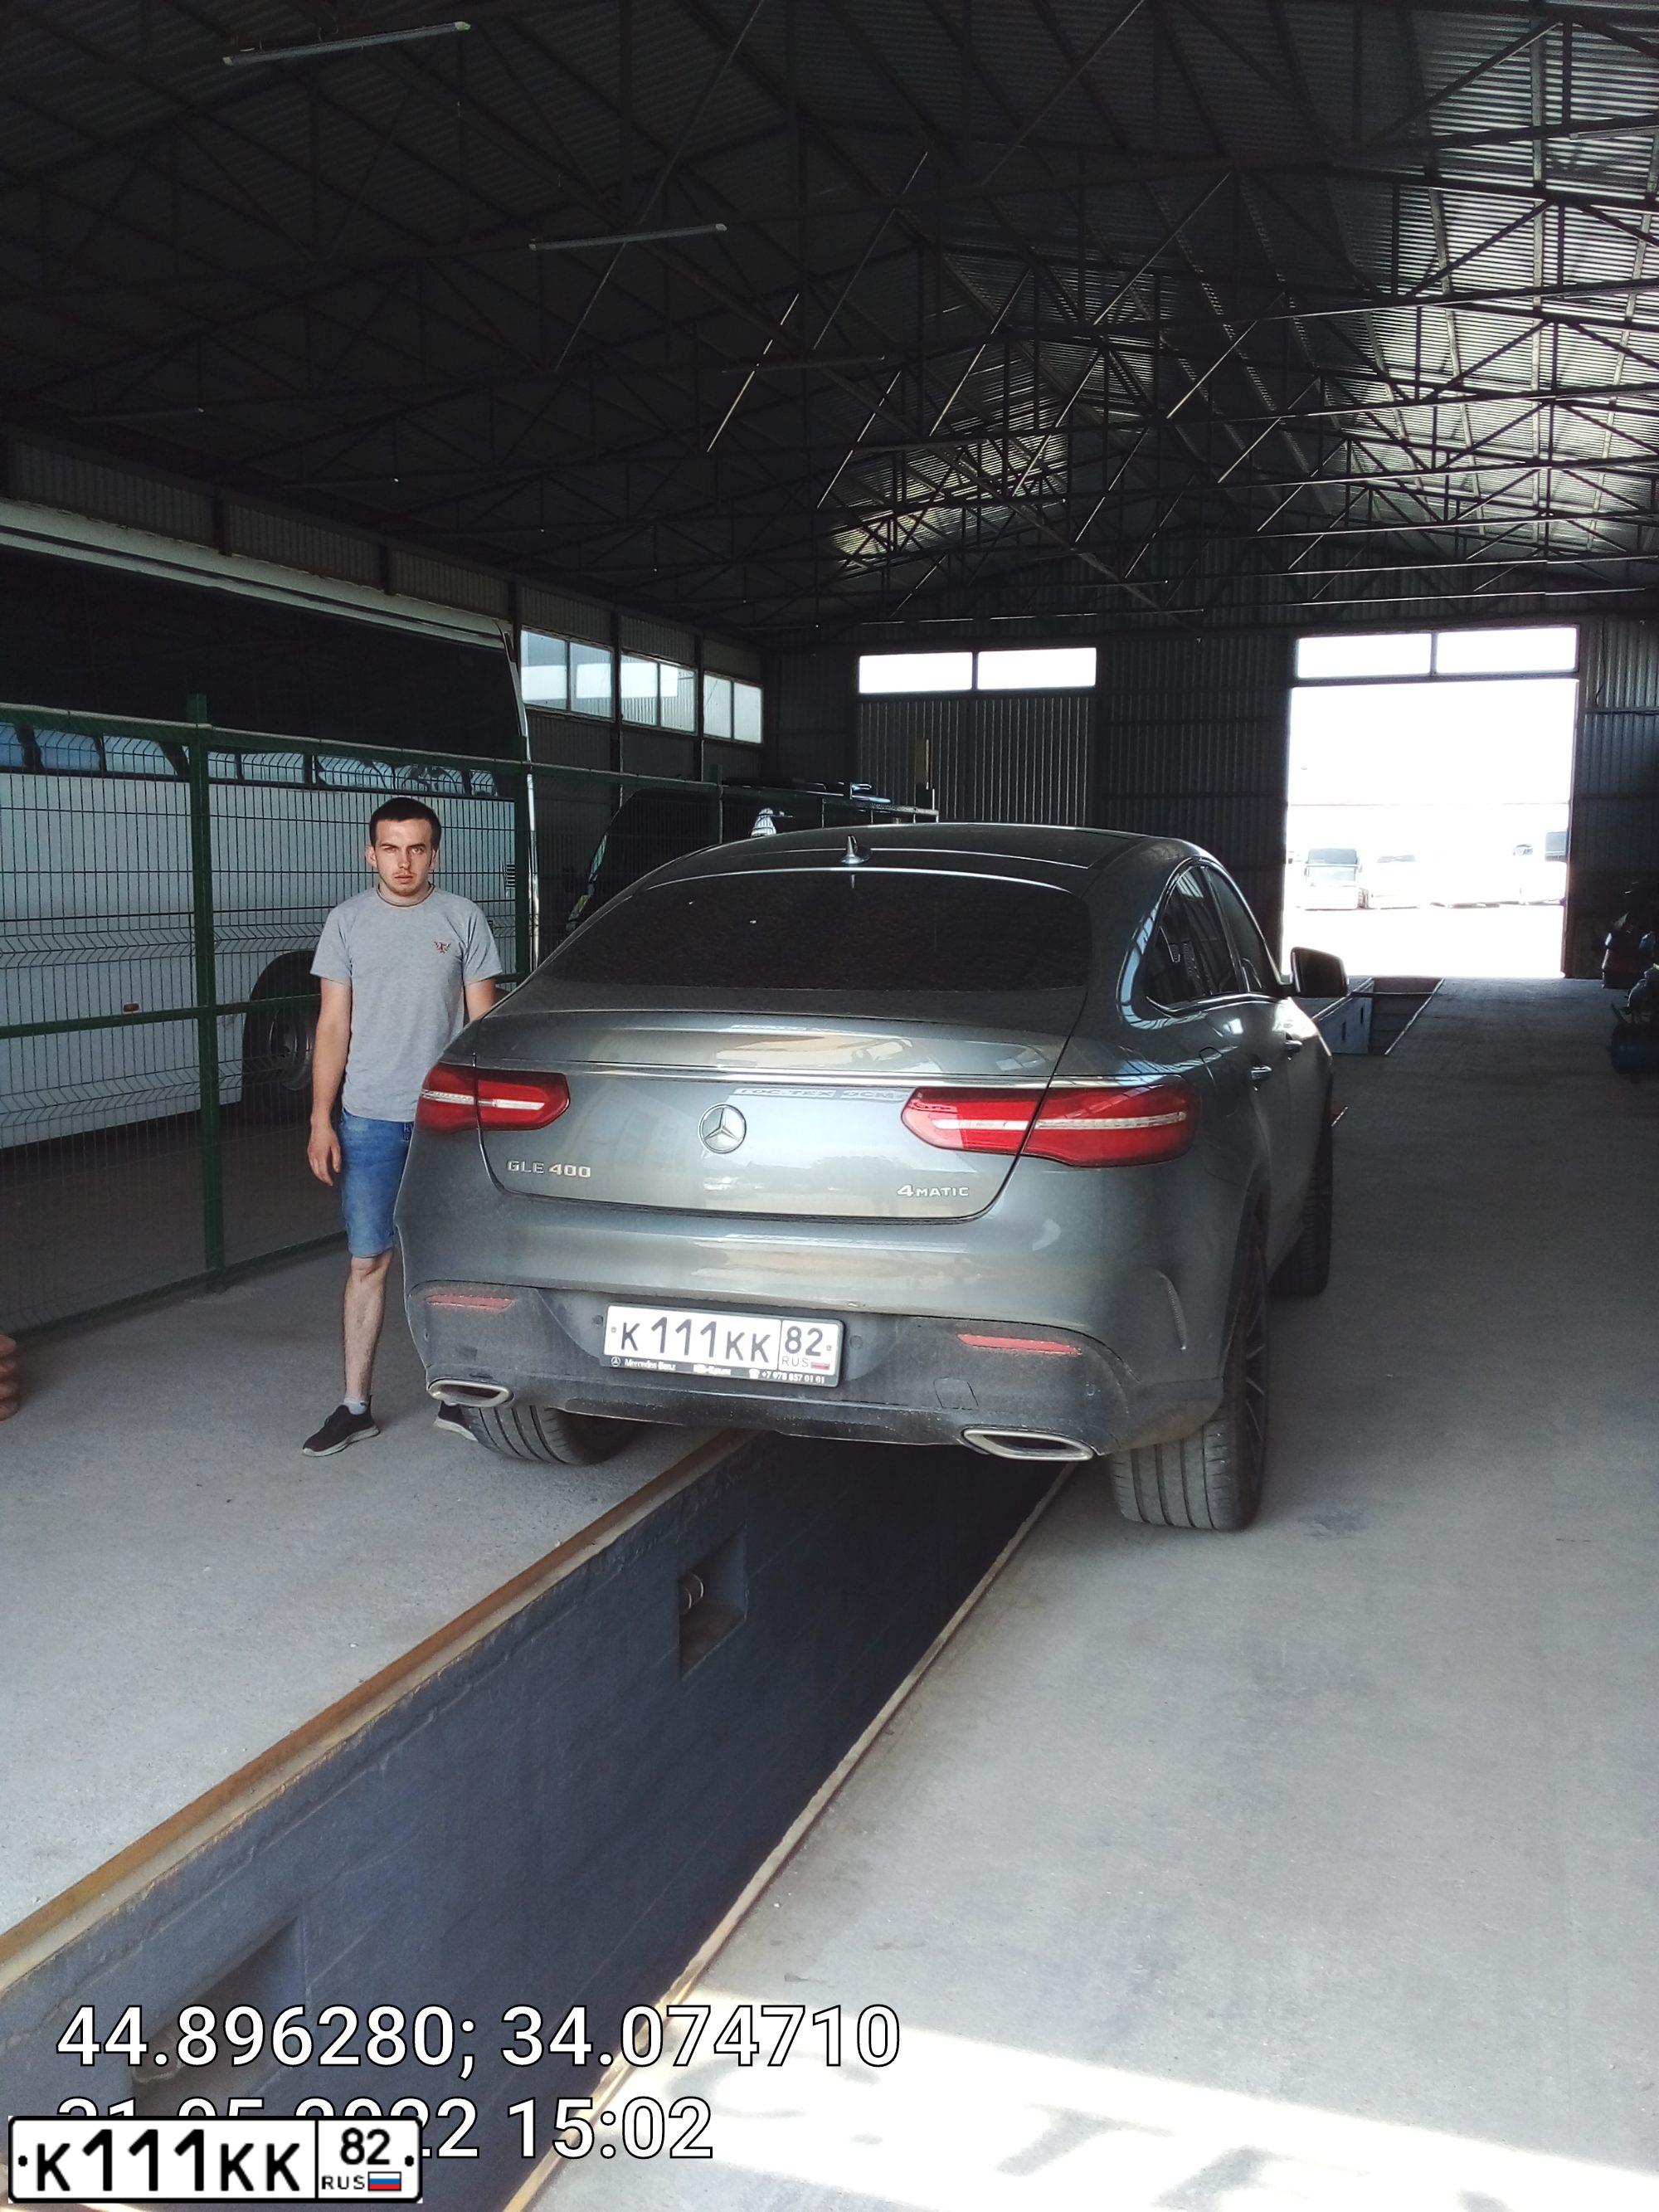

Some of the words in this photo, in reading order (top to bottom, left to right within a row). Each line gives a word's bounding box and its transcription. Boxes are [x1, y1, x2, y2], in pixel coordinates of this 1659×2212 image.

[507, 1161, 545, 1174] GLE
[549, 1164, 591, 1178] 400
[898, 1185, 969, 1197] 4MATIC
[785, 1326, 824, 1357] 82
[782, 1356, 809, 1368] RUS
